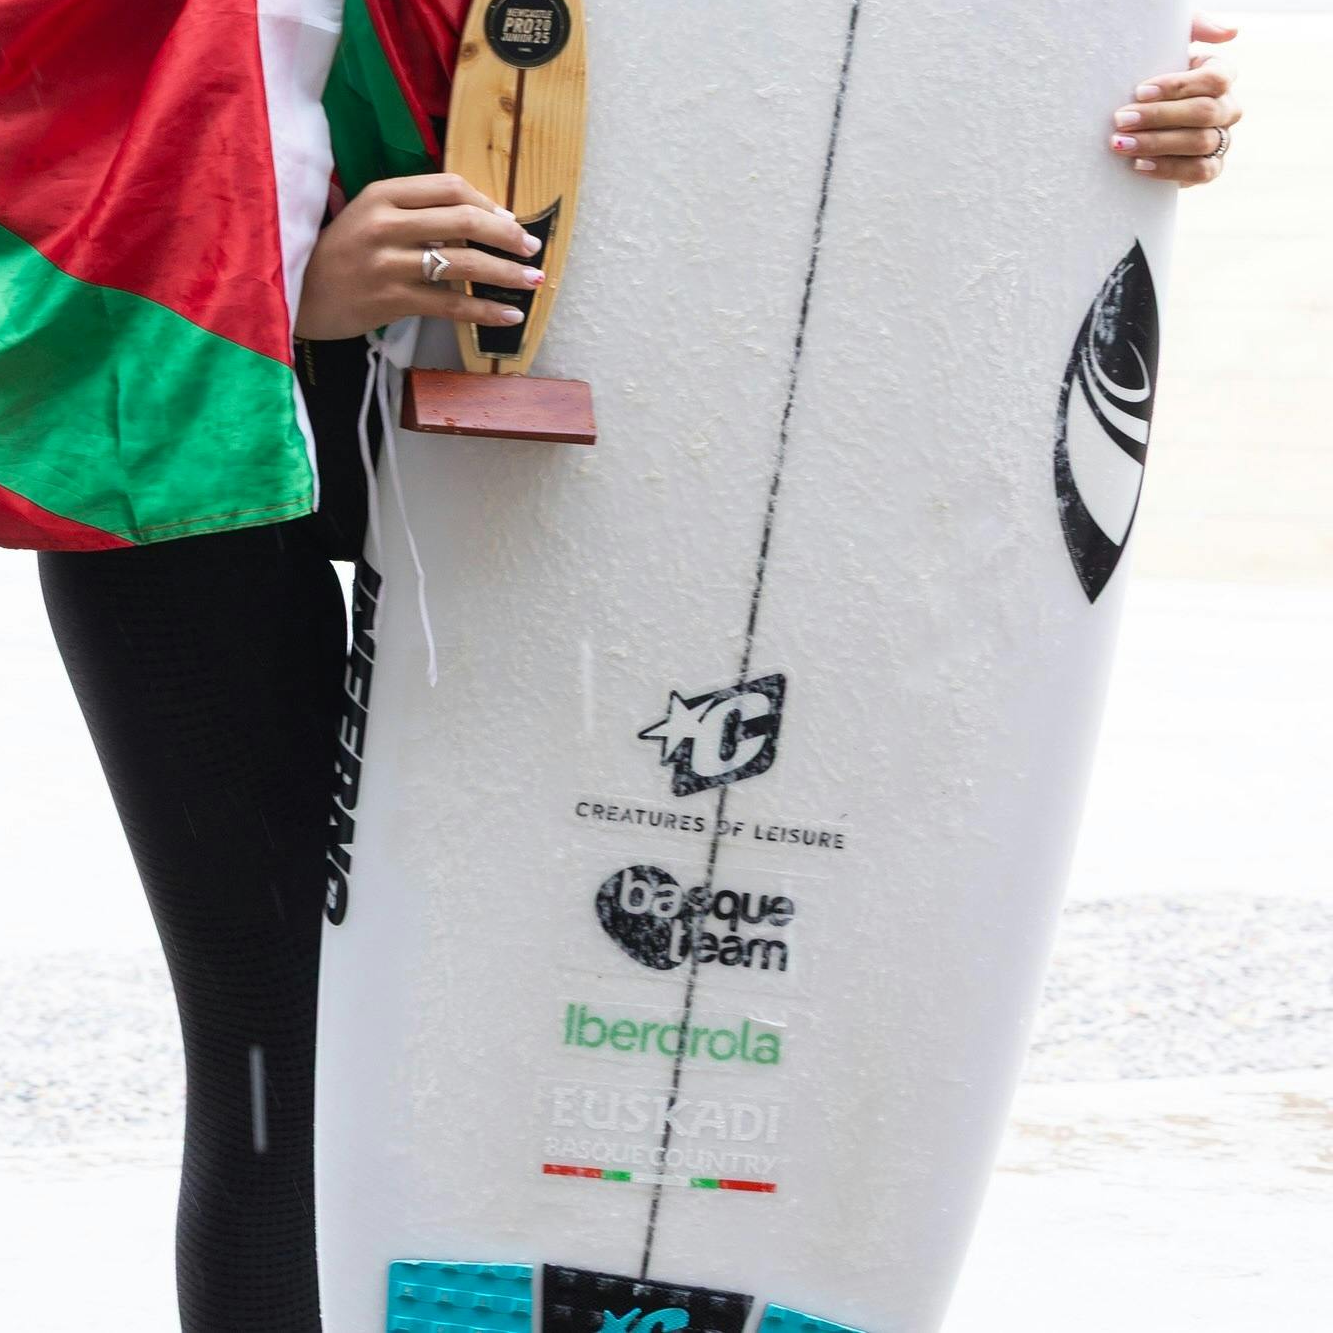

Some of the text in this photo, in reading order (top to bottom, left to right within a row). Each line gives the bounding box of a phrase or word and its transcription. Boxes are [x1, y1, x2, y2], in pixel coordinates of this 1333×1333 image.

[502, 17, 534, 34] PRO
[575, 801, 846, 850] CREATURES OF LEISURE
[619, 868, 795, 933] basque
[669, 918, 789, 972] team
[549, 1085, 782, 1145] EUSKADI
[543, 1136, 782, 1176] BASQUE COUNTRY
